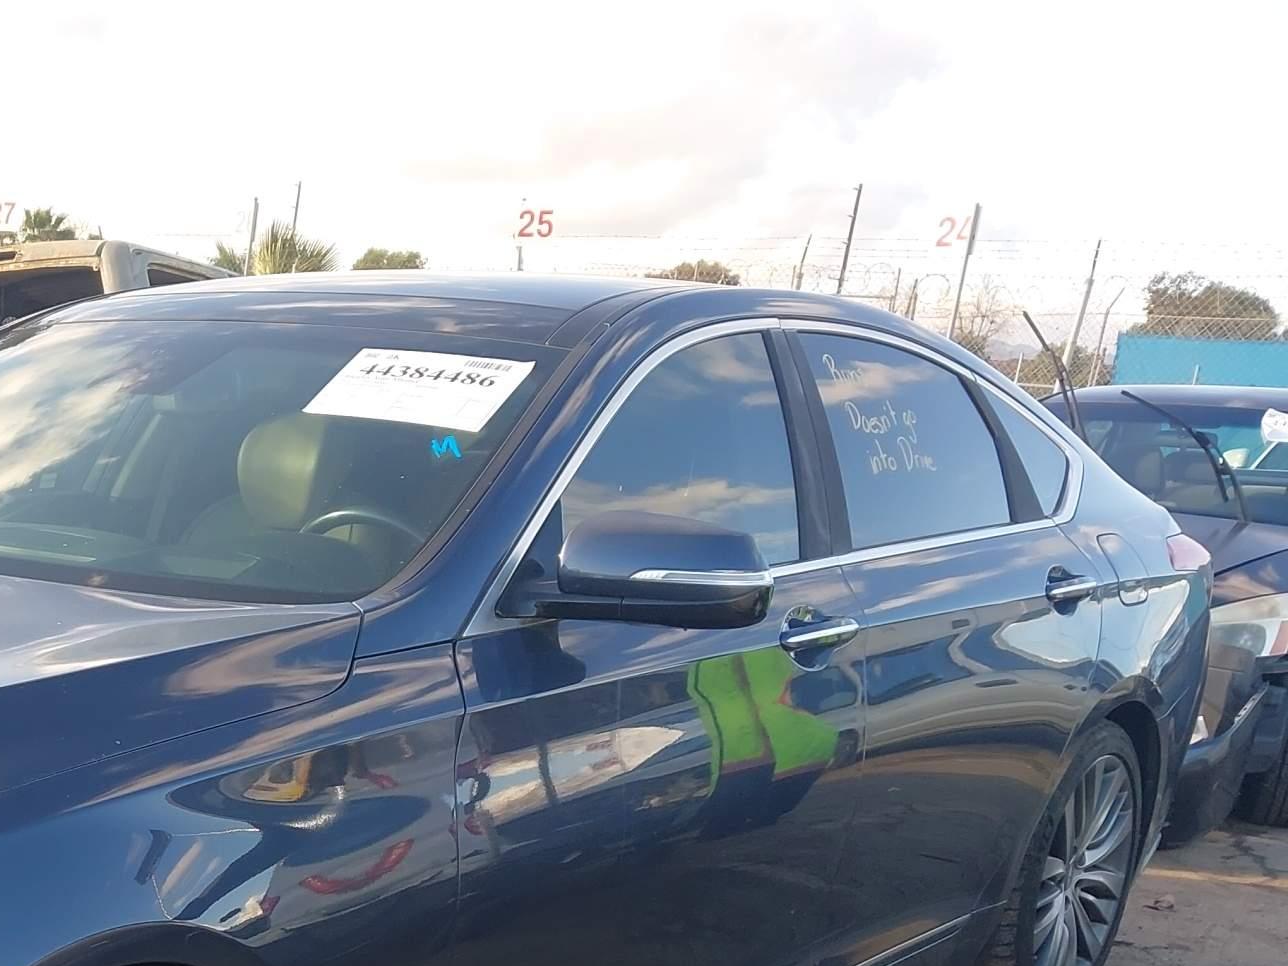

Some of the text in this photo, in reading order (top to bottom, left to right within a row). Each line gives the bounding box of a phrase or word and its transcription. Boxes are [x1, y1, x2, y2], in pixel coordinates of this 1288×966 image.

[518, 210, 554, 237] 25
[360, 363, 500, 388] 44384486
[866, 436, 937, 475] into Drive
